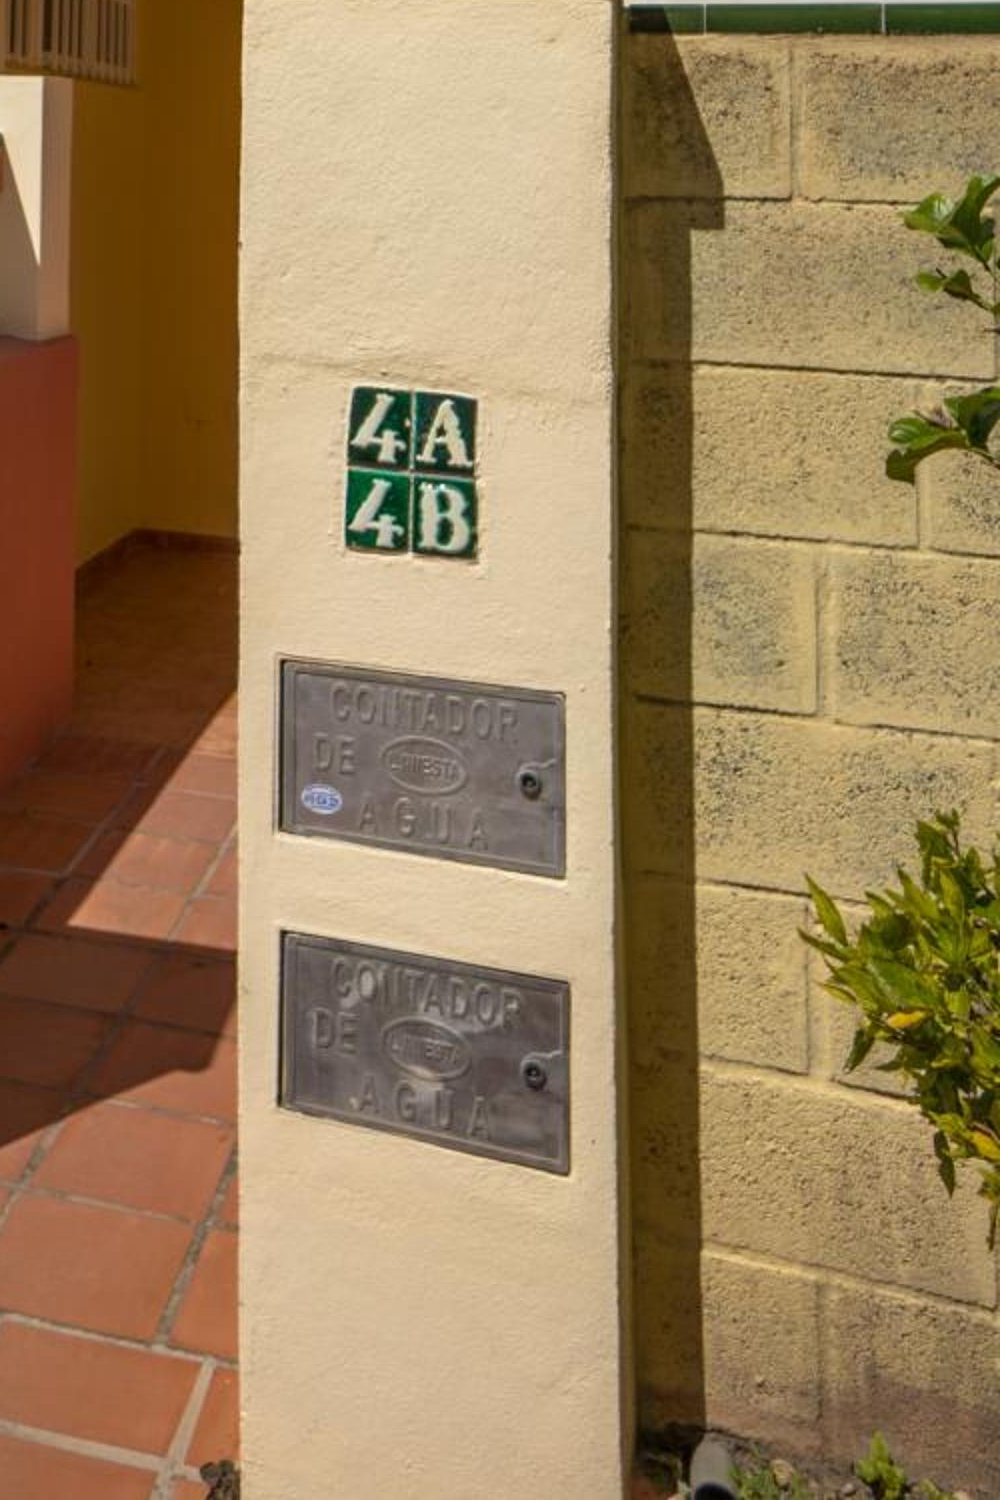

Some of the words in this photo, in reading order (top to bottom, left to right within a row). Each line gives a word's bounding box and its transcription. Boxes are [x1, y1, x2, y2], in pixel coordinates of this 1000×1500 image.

[350, 392, 474, 468] 4A
[347, 477, 470, 553] 4B
[331, 680, 519, 743] CONTADOR
[313, 732, 355, 775] DE
[358, 791, 490, 851] AGUA
[331, 955, 522, 1030] CONTADOR
[310, 1006, 359, 1055] DE
[358, 1075, 491, 1140] AGUA
